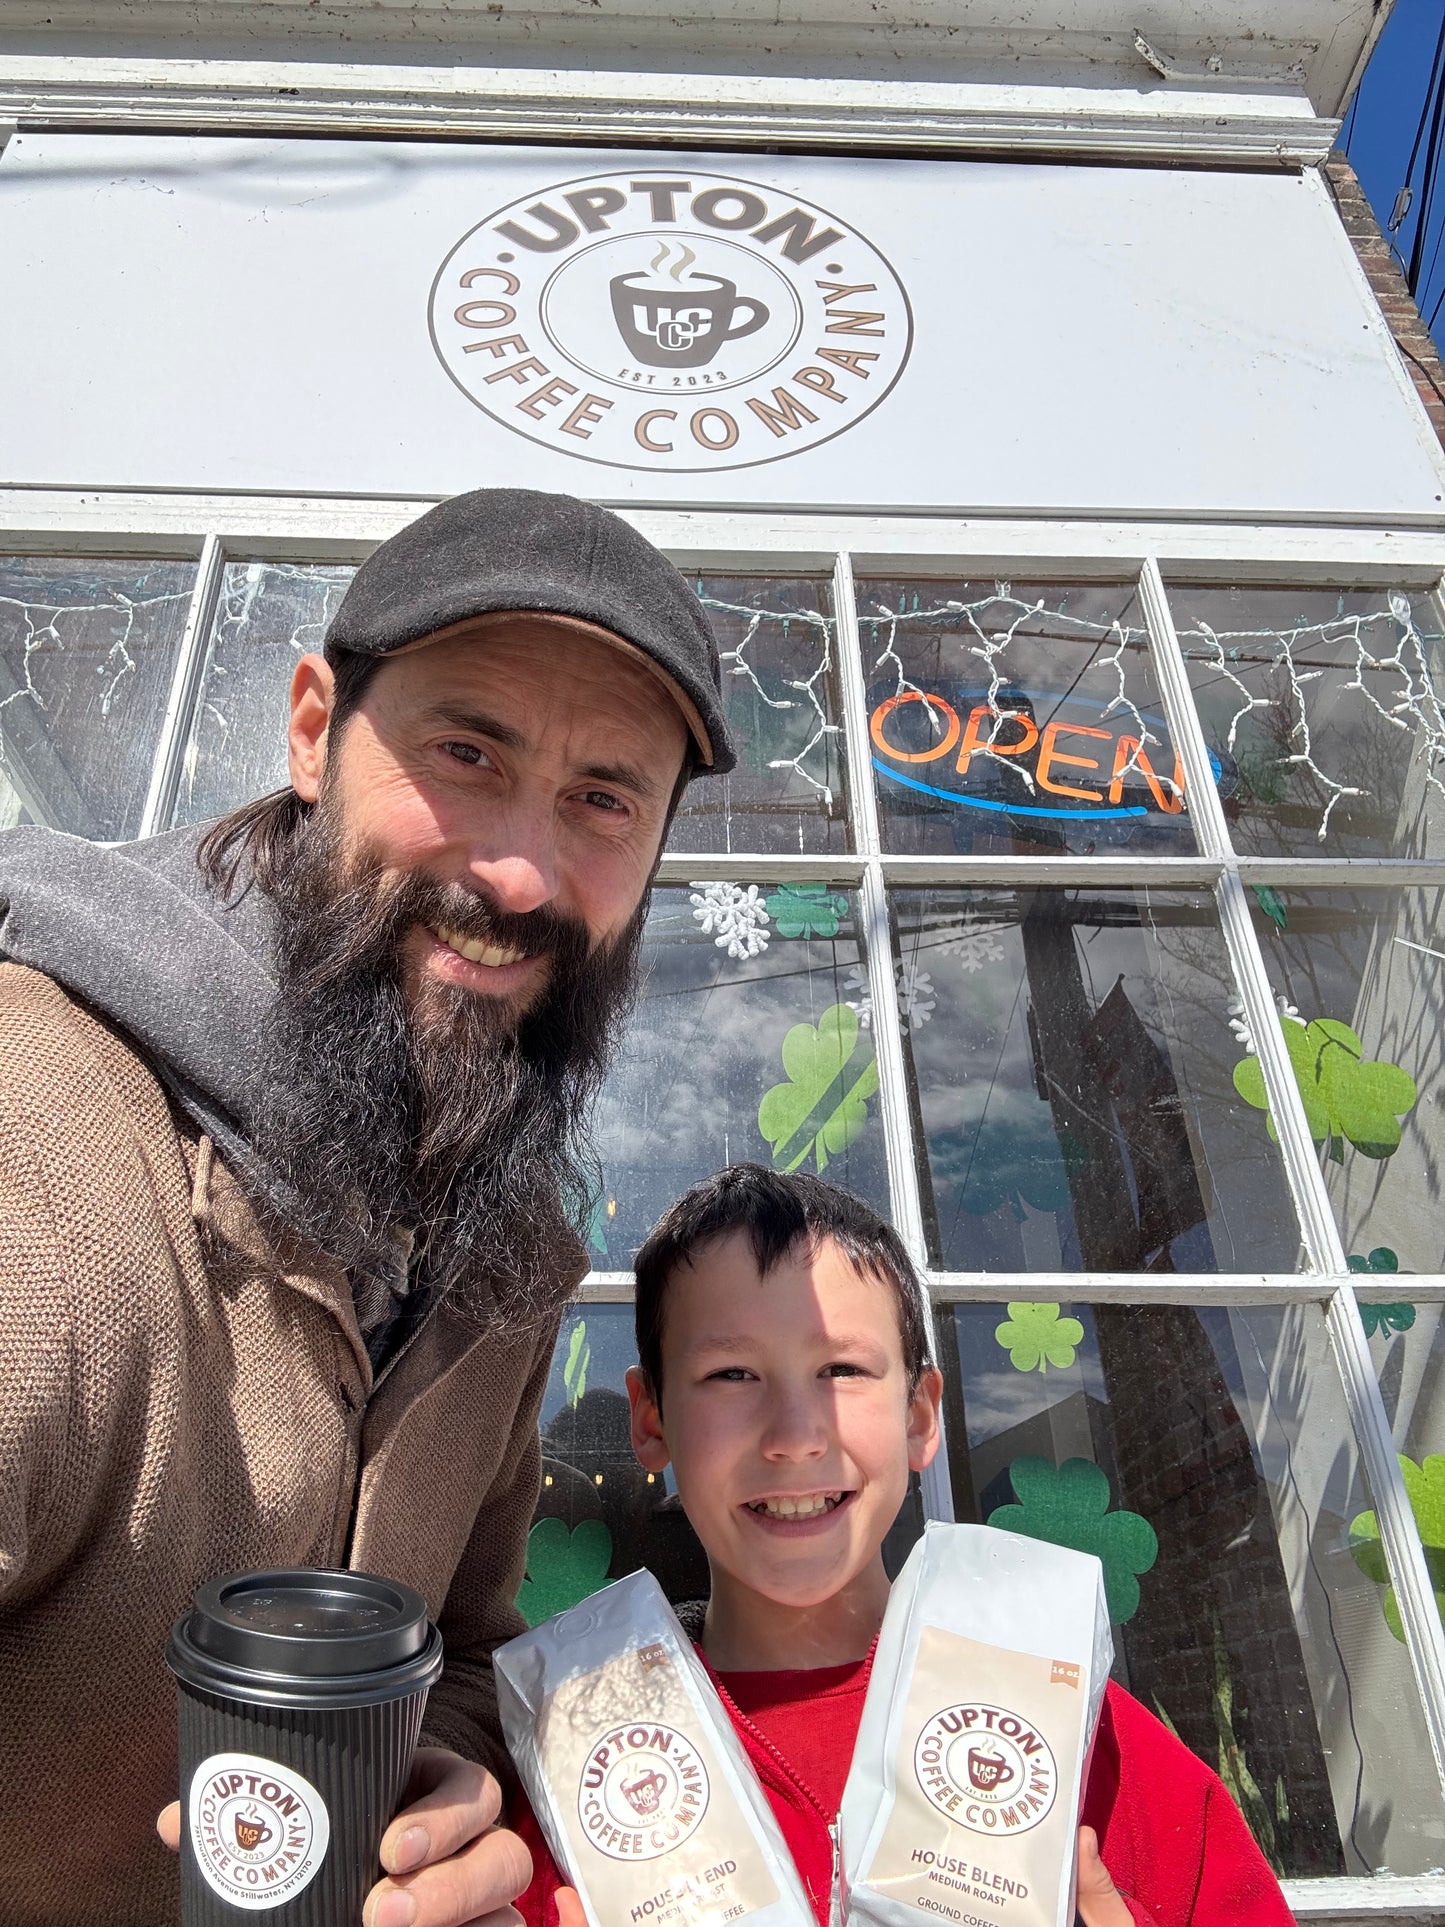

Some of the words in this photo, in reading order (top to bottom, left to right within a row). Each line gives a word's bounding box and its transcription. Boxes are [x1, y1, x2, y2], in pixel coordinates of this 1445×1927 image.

[492, 181, 847, 266] UPTON
[453, 267, 615, 441] COFFEE
[633, 280, 886, 453] COMPANY
[616, 368, 657, 386] EST
[673, 371, 729, 388] 2023
[870, 691, 1186, 814] OPEN
[640, 1652, 652, 1662] 16
[1052, 1666, 1065, 1676] 16
[1066, 1669, 1080, 1678] oz
[937, 1708, 1044, 1757] UPTON
[583, 1727, 674, 1790] UPTON
[921, 1735, 963, 1812] COFFEE
[965, 1763, 1050, 1828] COMPANY
[211, 1774, 302, 1818] UPTON
[584, 1800, 643, 1854] COFFEE
[650, 1753, 703, 1848] COMPANY
[202, 1797, 231, 1871] COFFEE
[233, 1824, 306, 1884] COMPANY
[228, 1841, 242, 1856] EST
[244, 1851, 265, 1860] 2023
[197, 1840, 214, 1873] Hudson
[212, 1873, 239, 1896] Avenue
[240, 1888, 285, 1900] Stillwater,
[283, 1879, 296, 1890] NY
[294, 1860, 313, 1881] 12170
[911, 1849, 968, 1877] HOUSE
[971, 1866, 1029, 1899] BLEND
[928, 1871, 971, 1894] MEDIUM
[972, 1887, 1007, 1907] ROAST
[917, 1896, 961, 1920] GROUND
[963, 1914, 999, 1927] COFF
